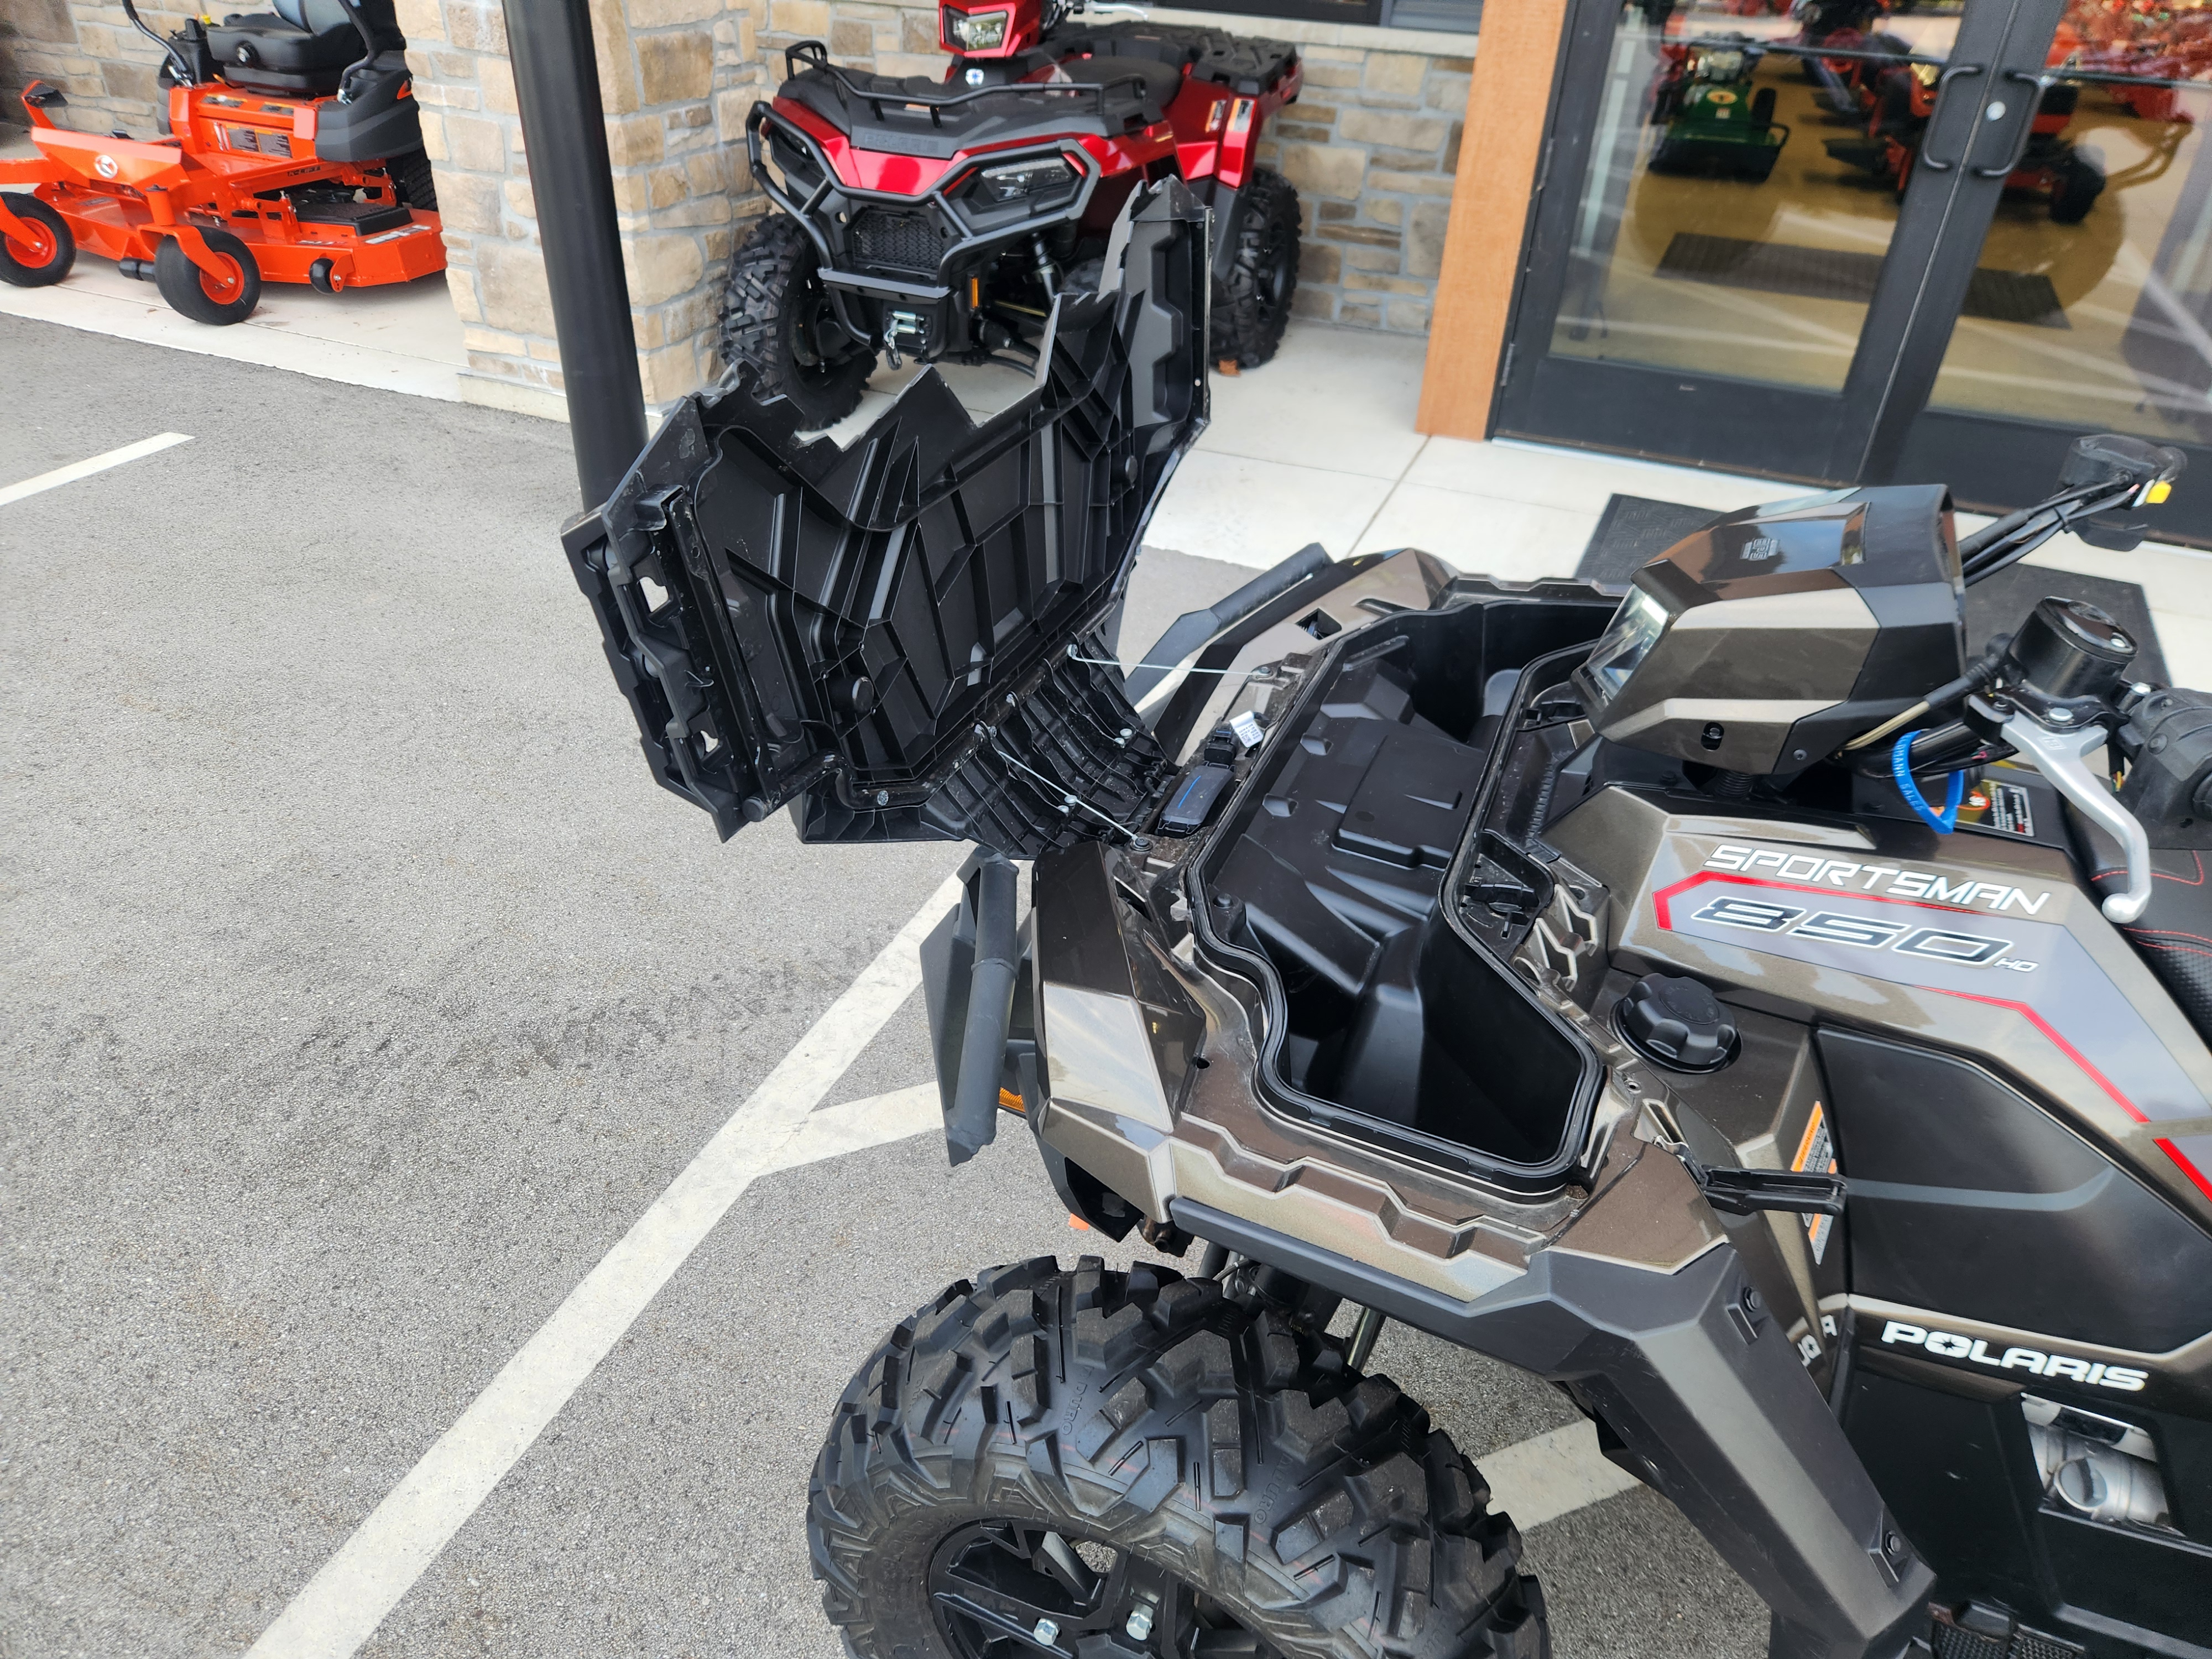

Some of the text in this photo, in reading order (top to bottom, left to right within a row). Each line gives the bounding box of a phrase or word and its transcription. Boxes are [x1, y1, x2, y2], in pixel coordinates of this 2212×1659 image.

[1704, 844, 2051, 915] SPORTSMAN
[1691, 895, 2015, 967] 850
[1881, 1321, 2149, 1391] POLARIS
